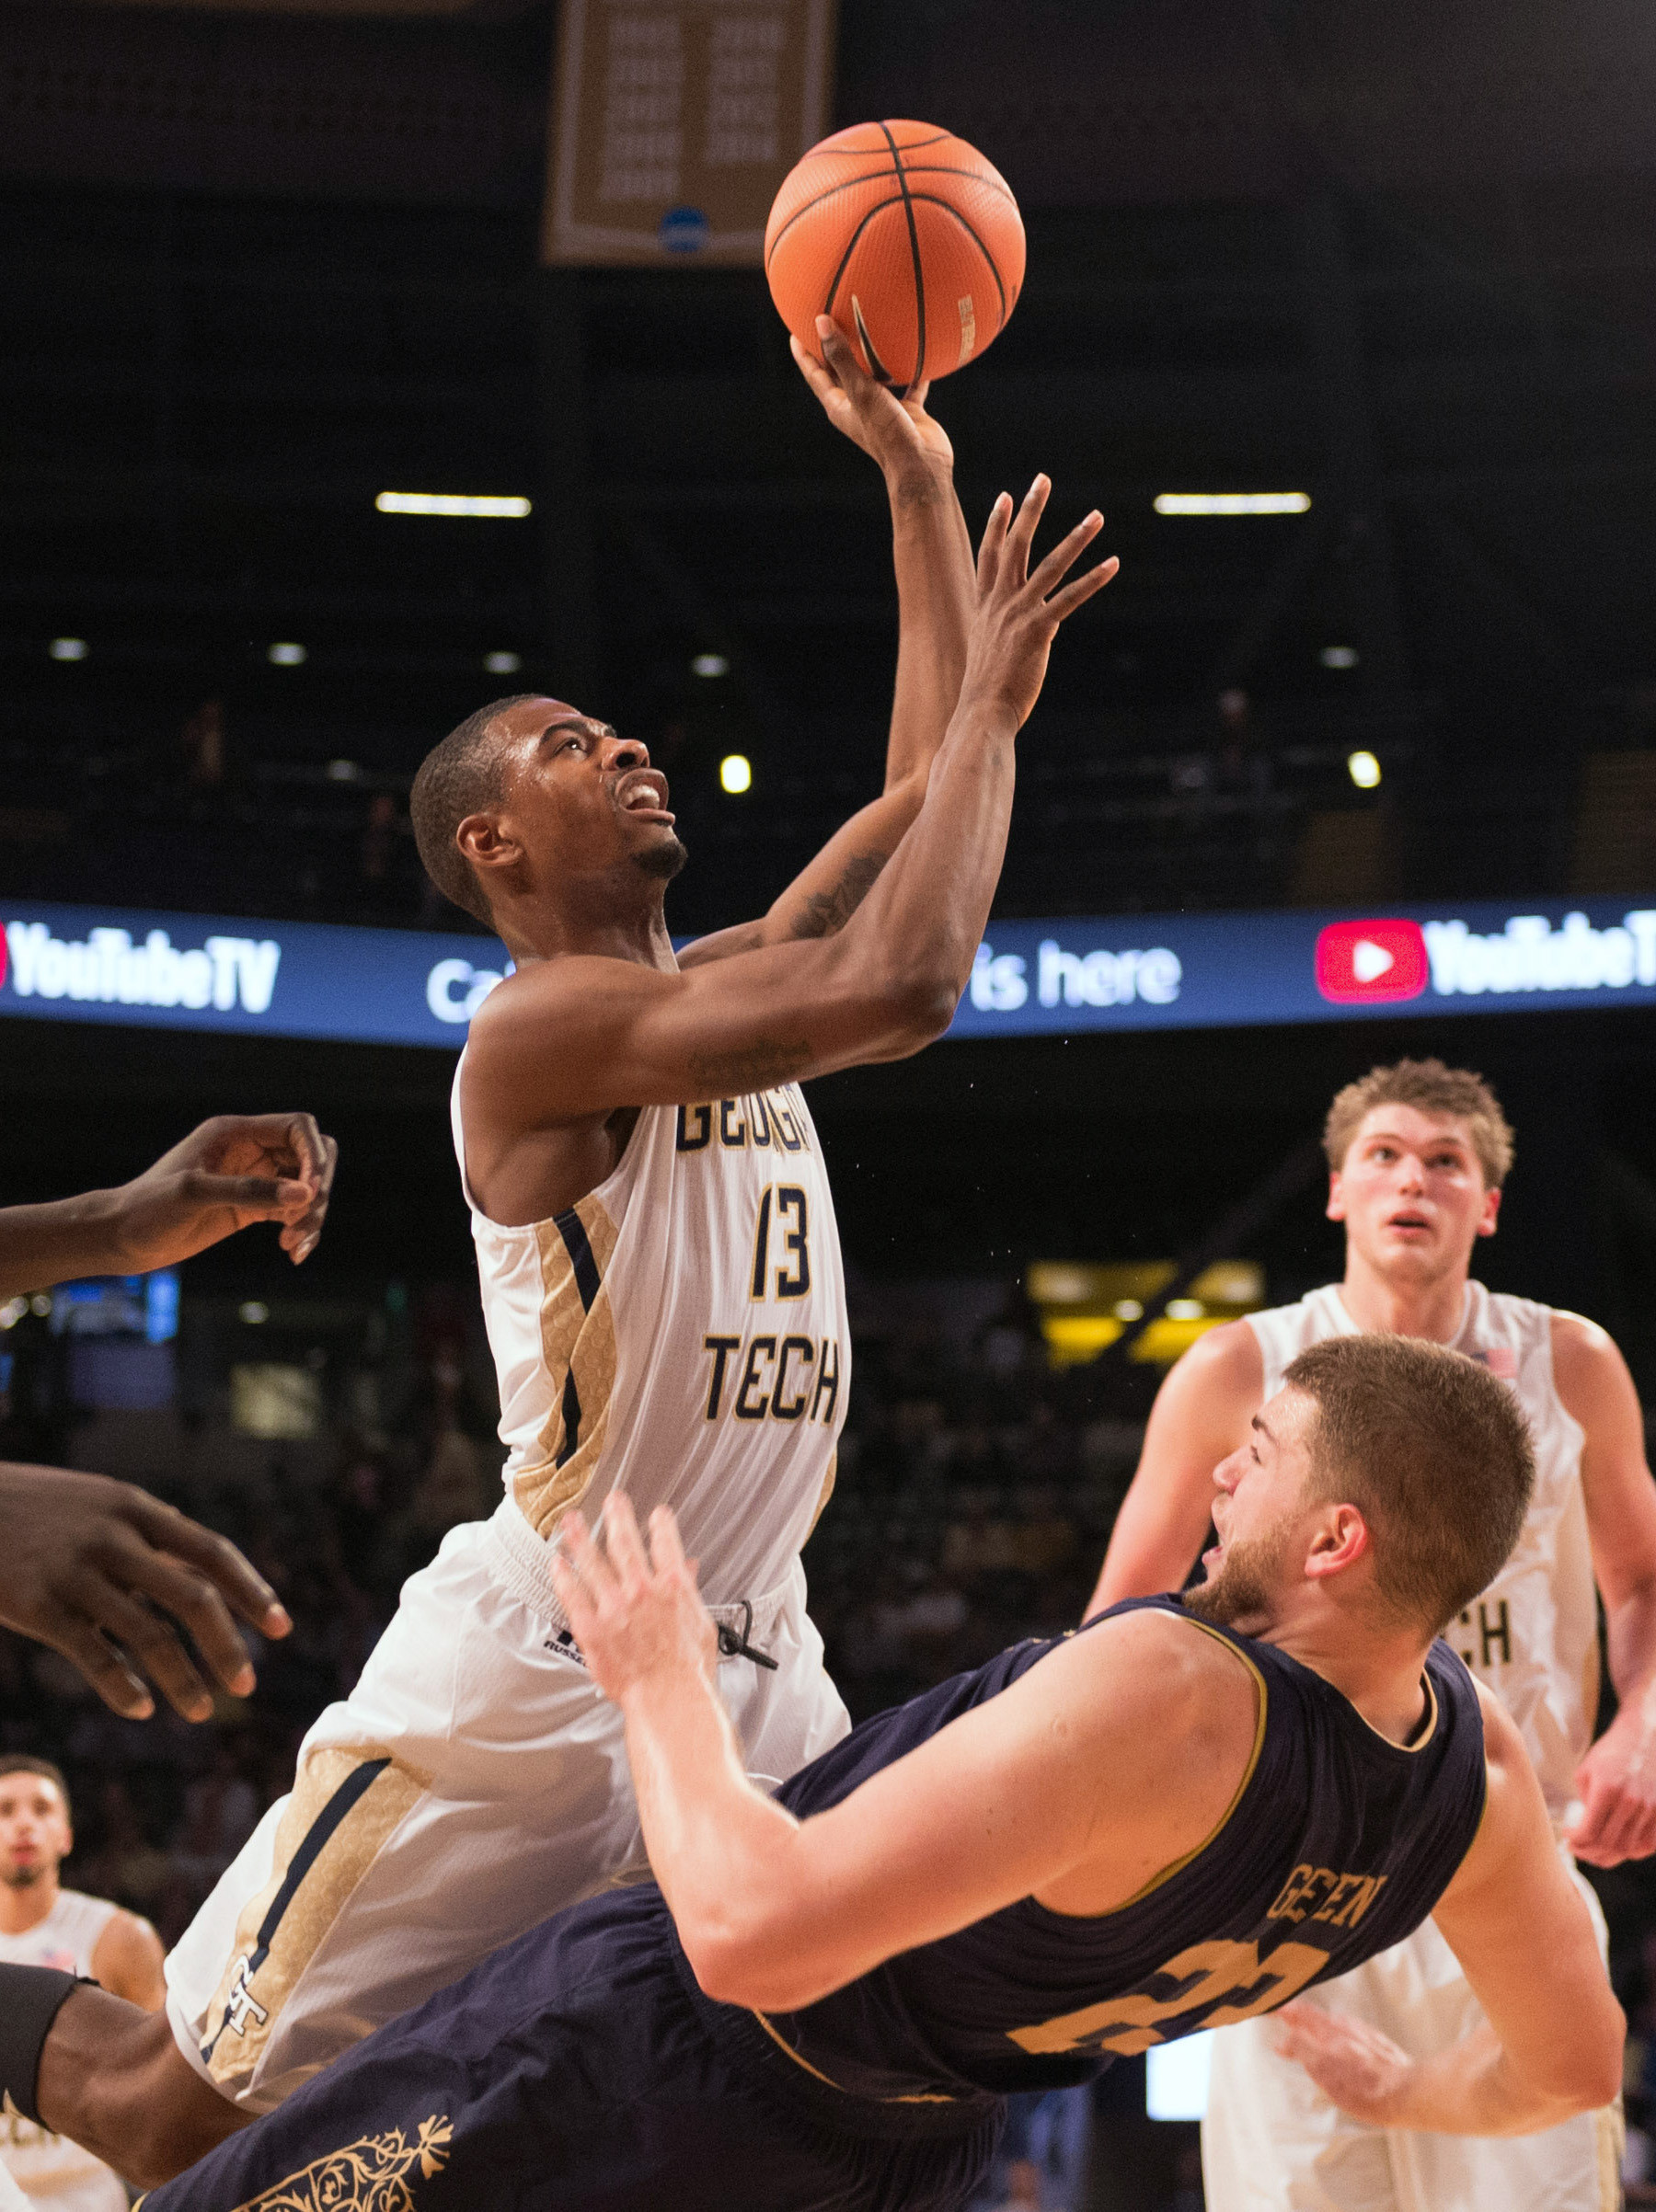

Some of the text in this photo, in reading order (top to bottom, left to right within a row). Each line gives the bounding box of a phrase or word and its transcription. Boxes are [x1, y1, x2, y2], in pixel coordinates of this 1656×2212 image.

[971, 942, 1029, 1011] is
[1038, 939, 1182, 1008] here
[749, 1182, 812, 1302] 13
[703, 1333, 840, 1427] TECH
[543, 1639, 586, 1668] RUSSE
